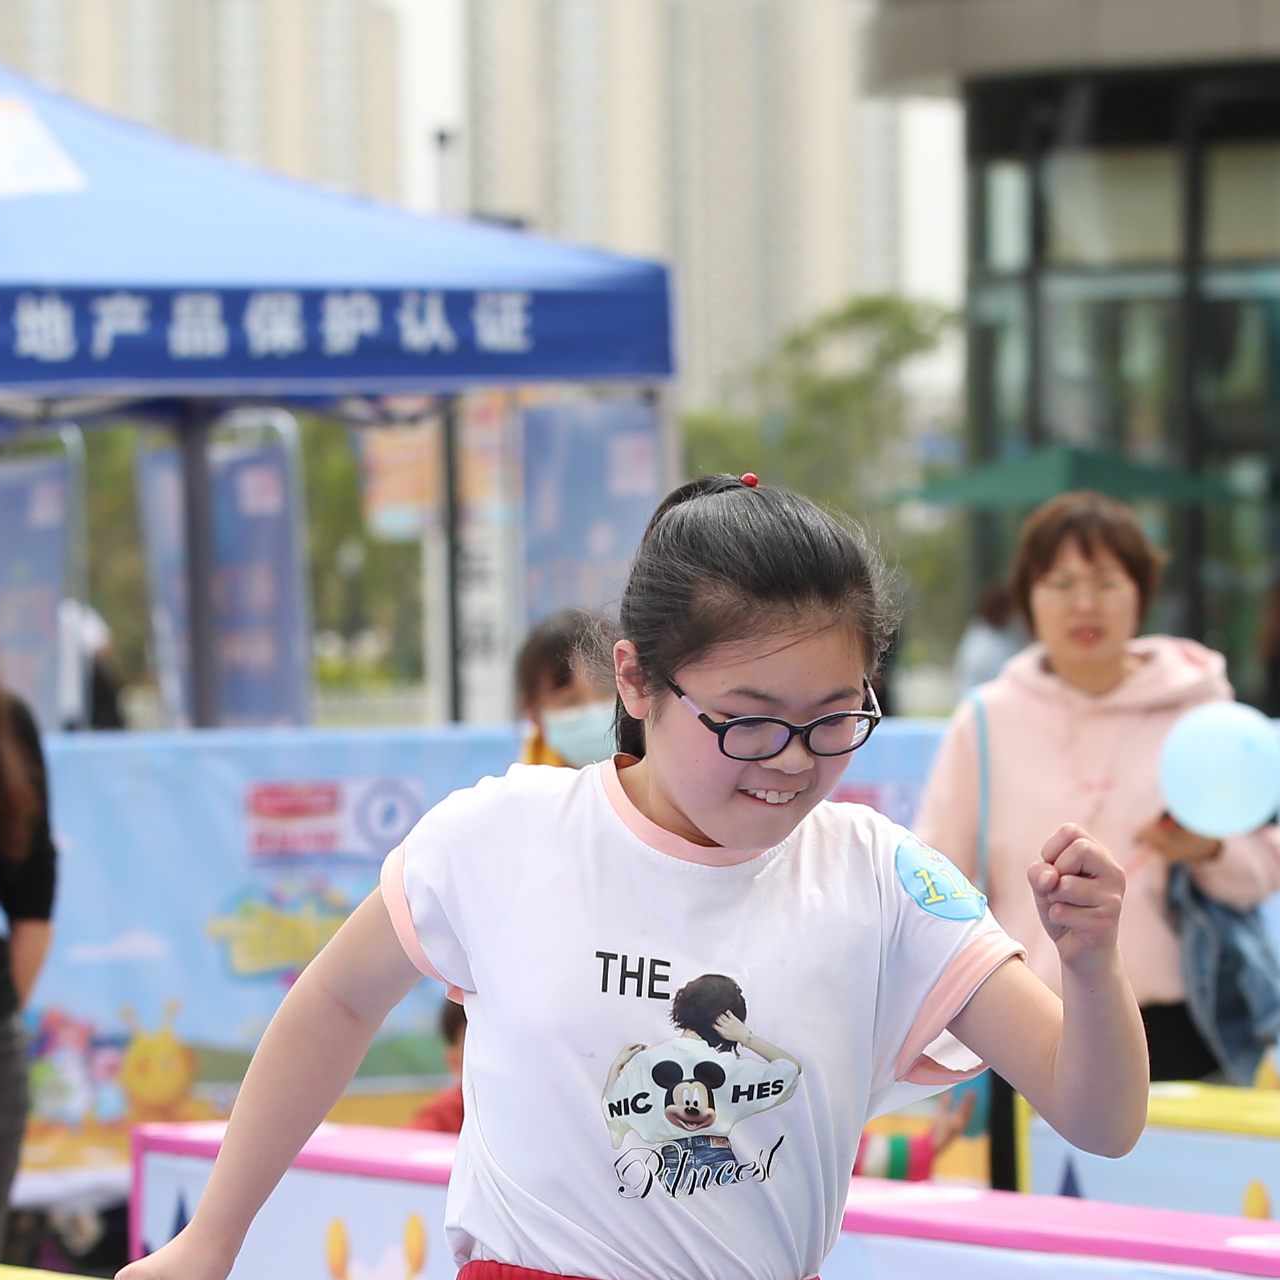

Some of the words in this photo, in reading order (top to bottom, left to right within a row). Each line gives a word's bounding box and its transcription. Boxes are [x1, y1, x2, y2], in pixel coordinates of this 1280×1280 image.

[595, 949, 672, 1000] THE
[607, 1091, 653, 1119] NIC
[731, 1078, 785, 1104] HES
